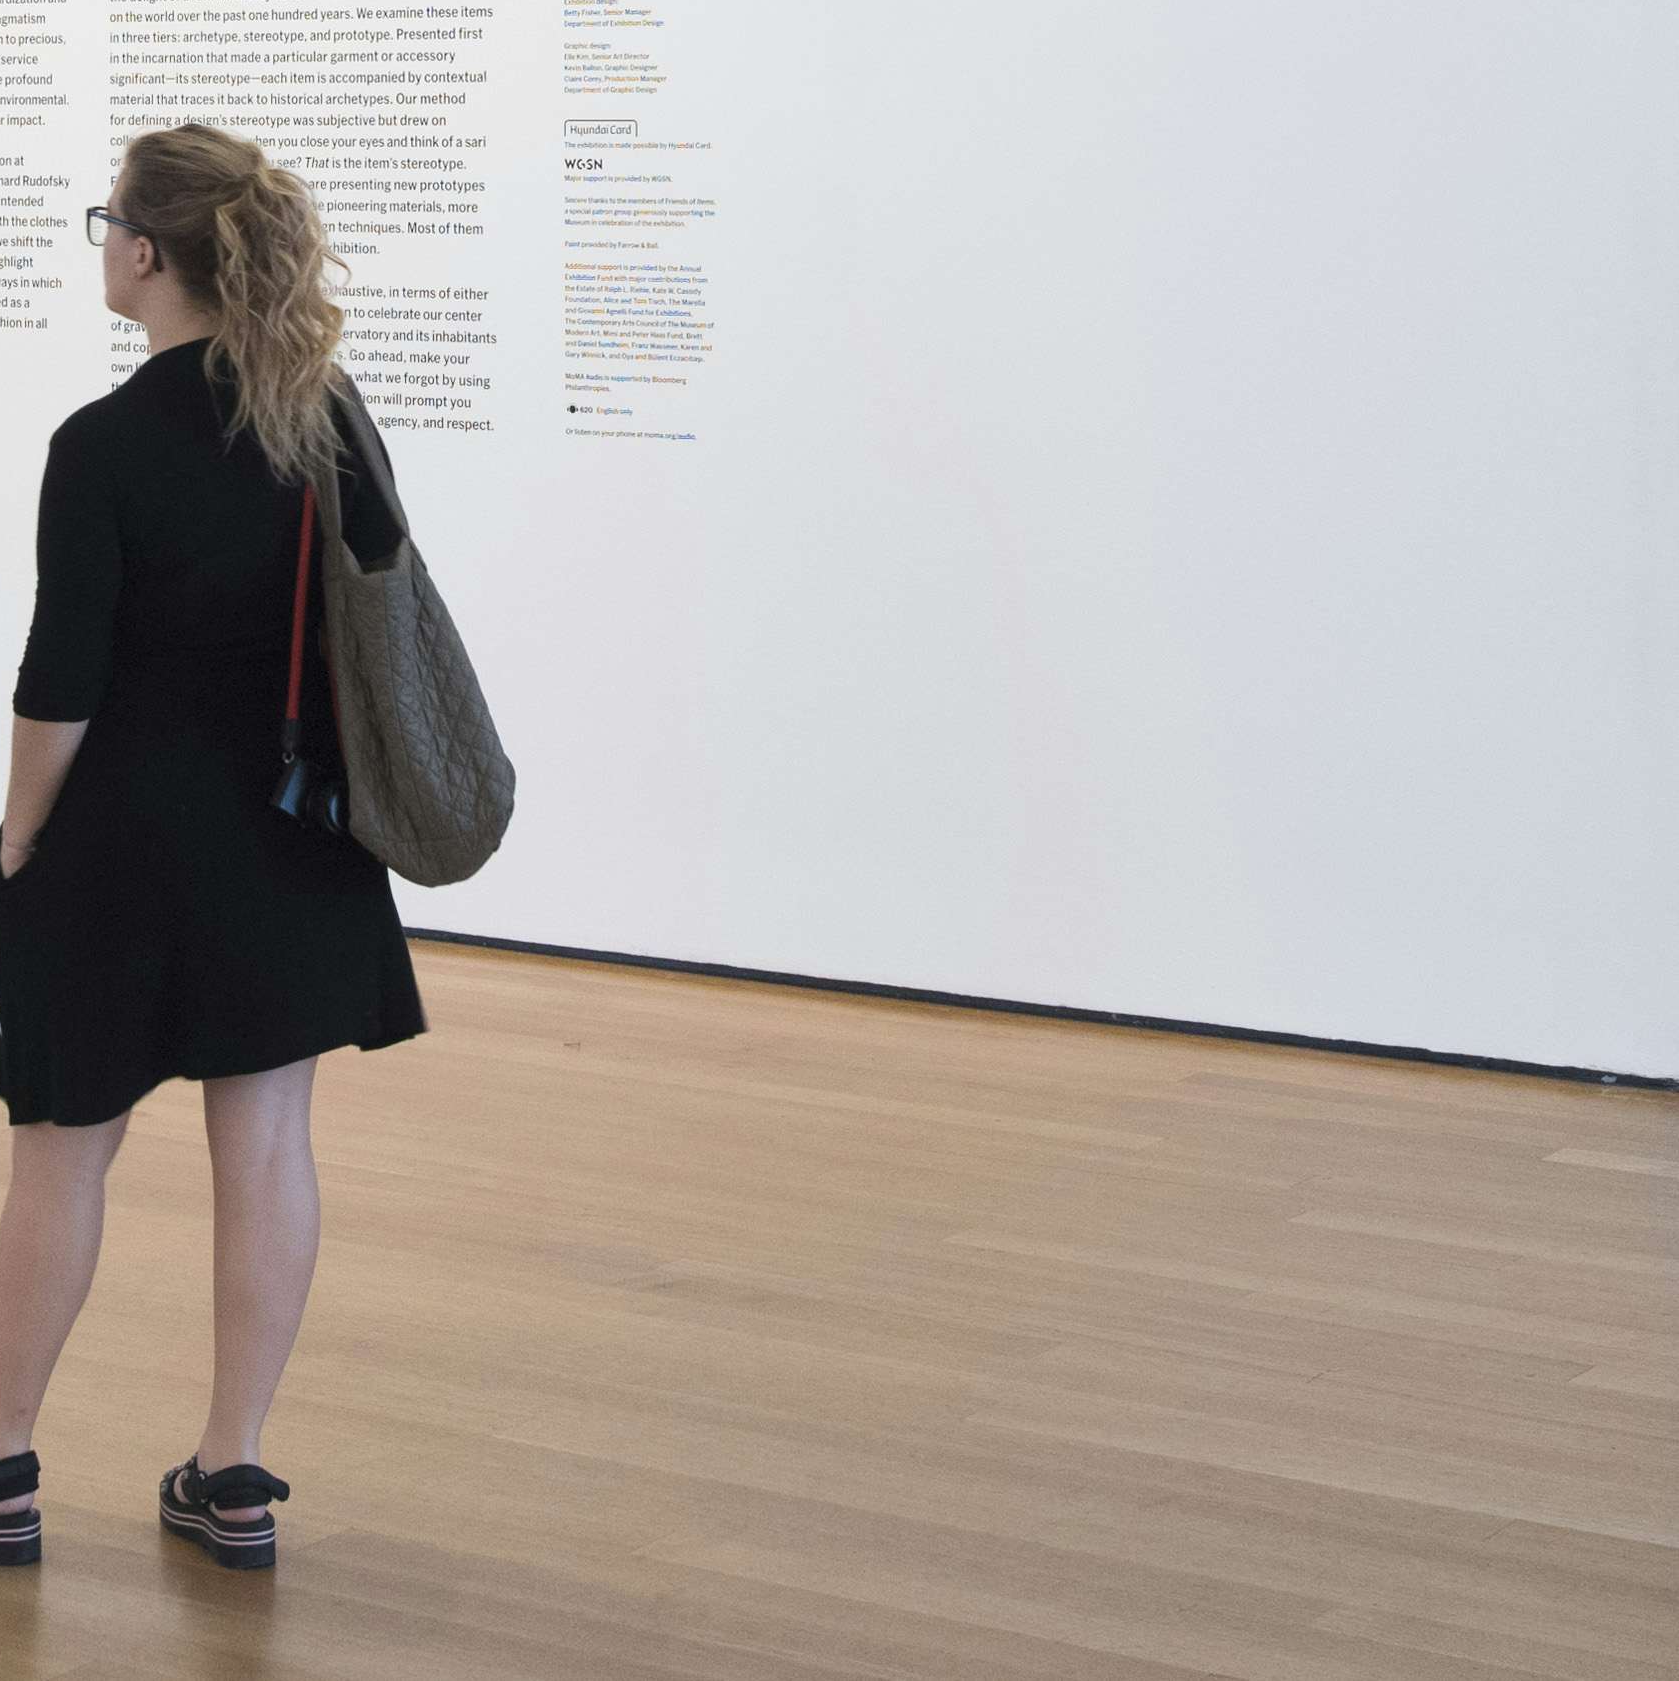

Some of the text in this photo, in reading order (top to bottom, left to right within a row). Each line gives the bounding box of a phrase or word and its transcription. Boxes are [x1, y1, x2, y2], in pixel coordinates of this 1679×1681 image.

[109, 50, 456, 66] in the incarnation that made a particular garment or accessory
[6, 114, 46, 128] impact.
[570, 125, 632, 136] Hyundai Card
[564, 158, 603, 170] WGSN
[22, 174, 71, 190] Rudofsky
[349, 349, 471, 367] Go ahead, make your
[377, 416, 495, 433] agency, and respect.
